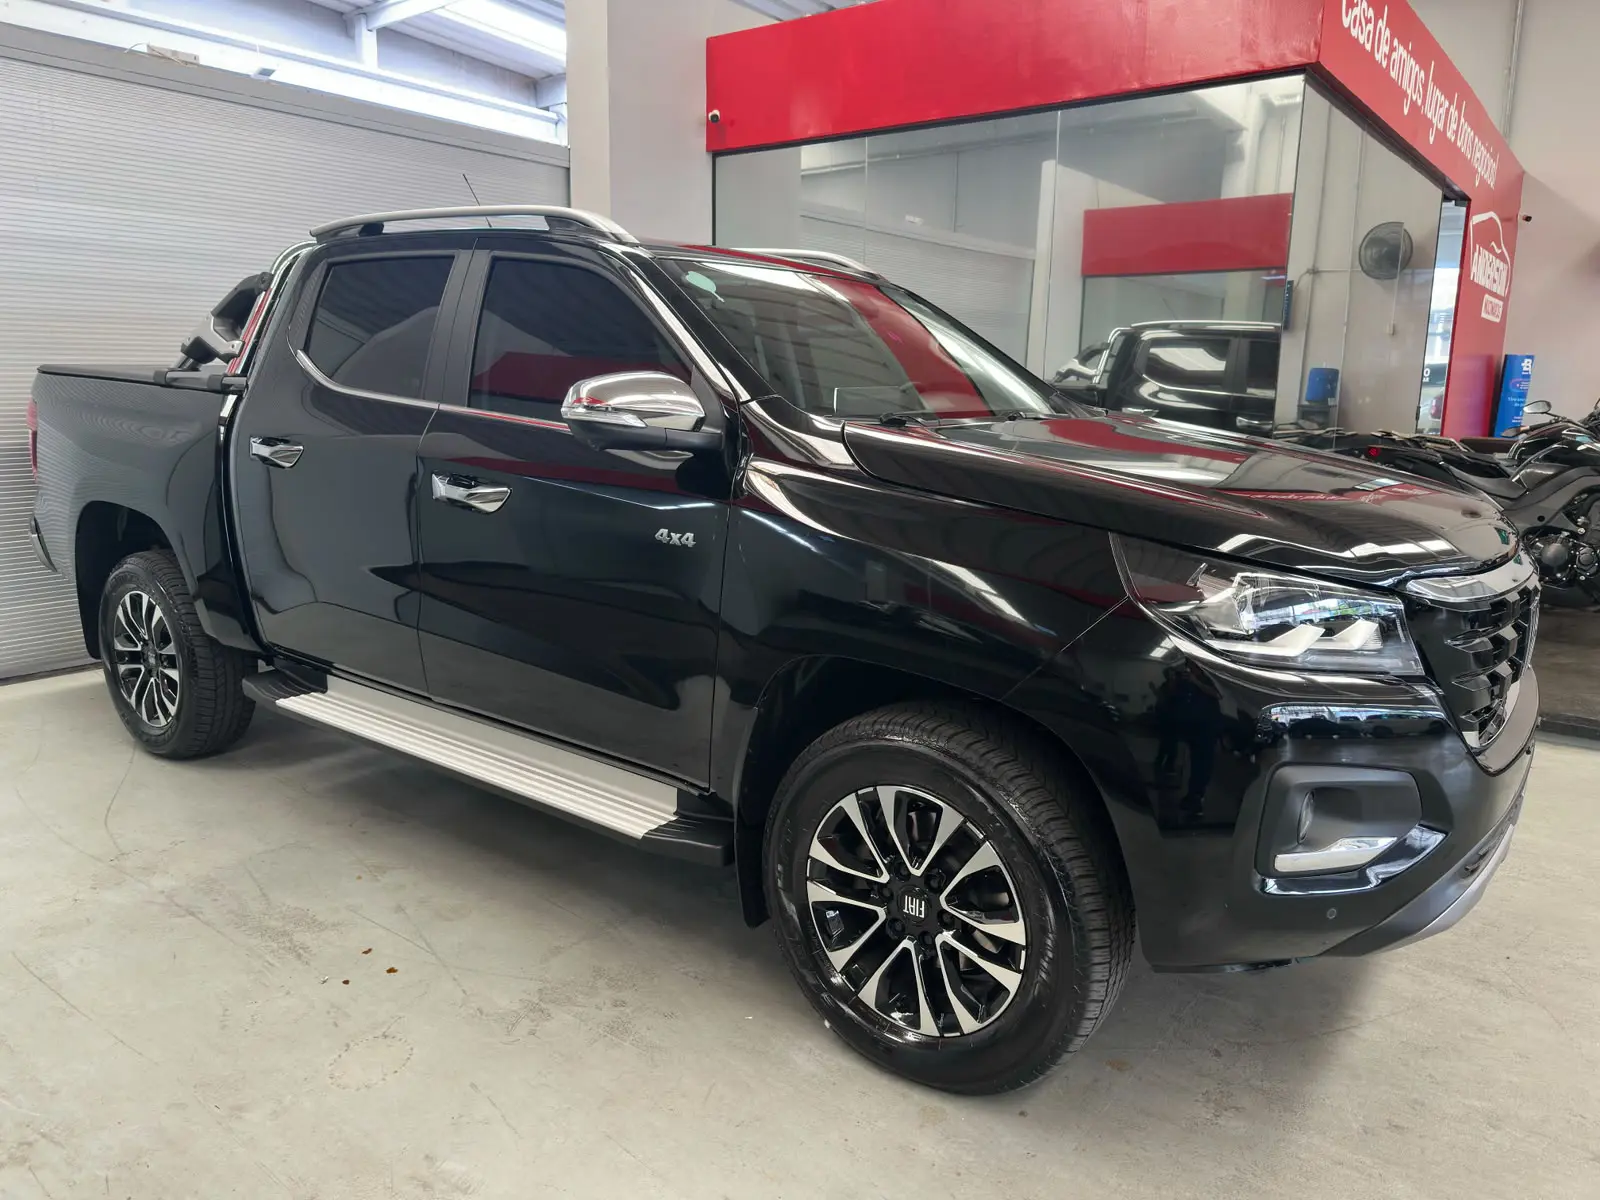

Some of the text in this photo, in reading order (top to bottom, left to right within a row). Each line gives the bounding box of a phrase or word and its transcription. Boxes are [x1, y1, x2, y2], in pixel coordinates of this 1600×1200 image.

[1374, 4, 1391, 69] de
[1424, 60, 1450, 144] lugar
[1446, 92, 1458, 143] de
[1457, 100, 1474, 160] bons
[655, 528, 696, 548] 4x4
[902, 895, 925, 919] FIAT
